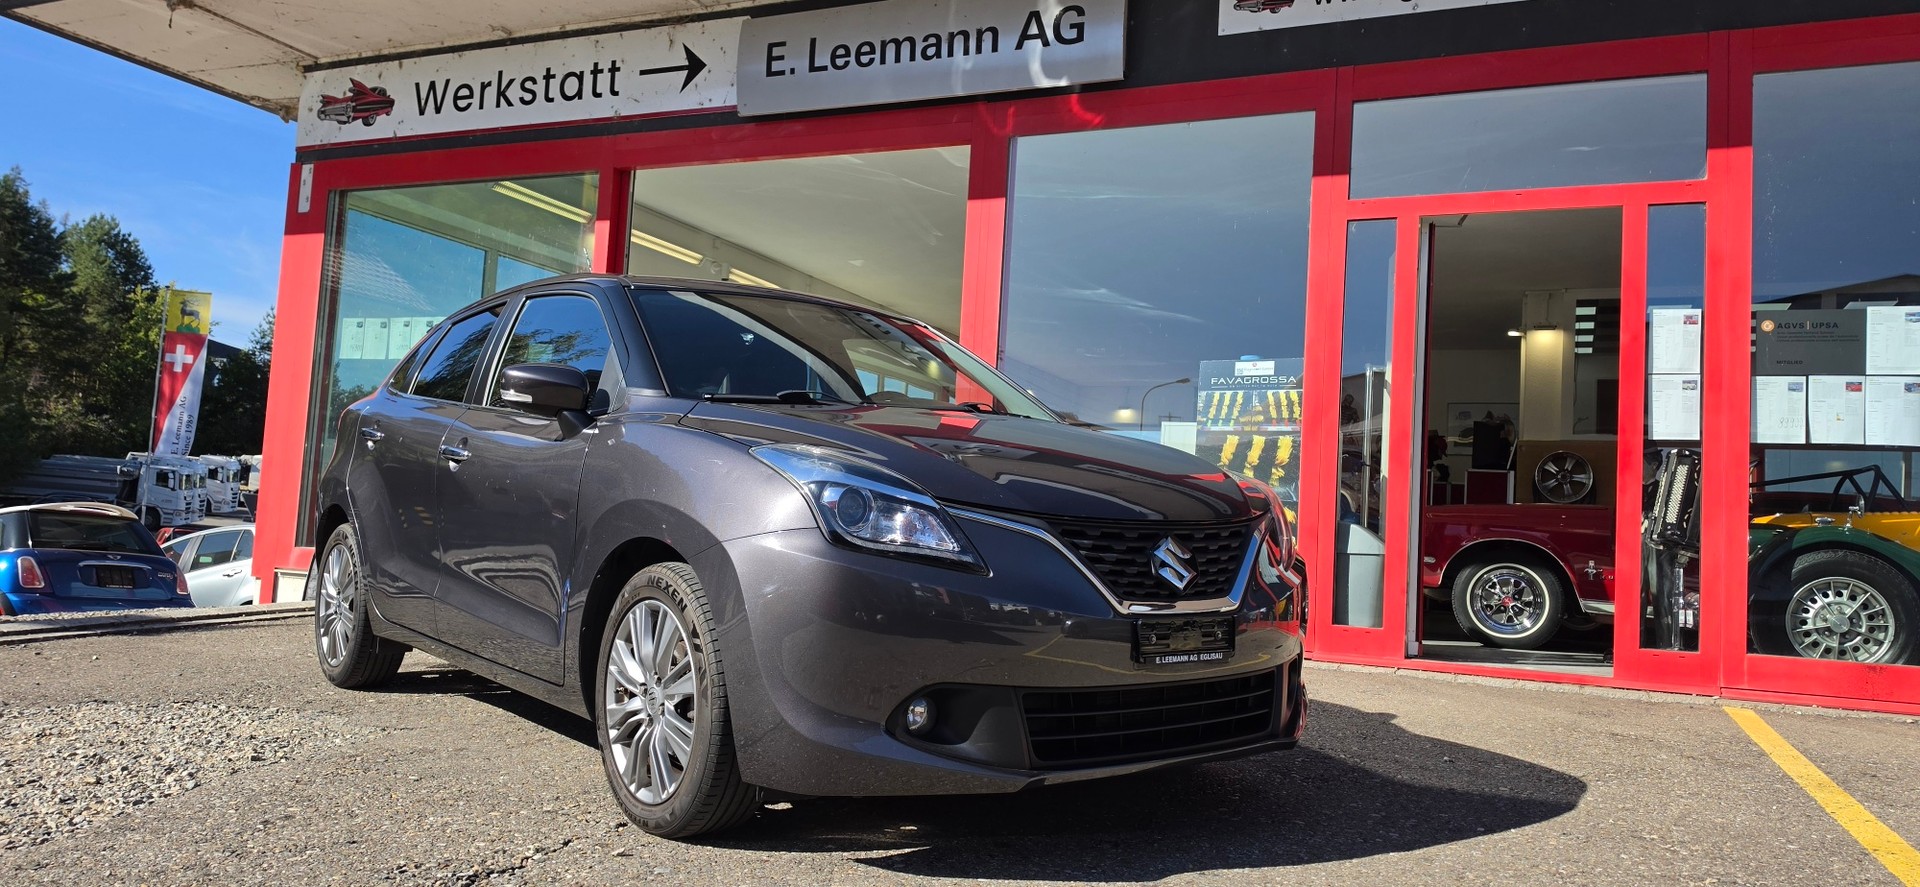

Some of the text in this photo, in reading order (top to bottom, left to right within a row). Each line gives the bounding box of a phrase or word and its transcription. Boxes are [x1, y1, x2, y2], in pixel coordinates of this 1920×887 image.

[765, 4, 1086, 78] E. Leemann AG
[414, 59, 622, 117] Werkstatt
[1811, 321, 1839, 329] UPSA
[1211, 376, 1297, 385] FAVAGROSSA
[171, 396, 187, 455] E. Leemann AG
[181, 414, 195, 456] Since 1989
[646, 575, 688, 613] NEXEN
[1155, 656, 1162, 664] E.
[1162, 655, 1189, 663] LEEMANN
[1200, 652, 1223, 660] EGLISAU
